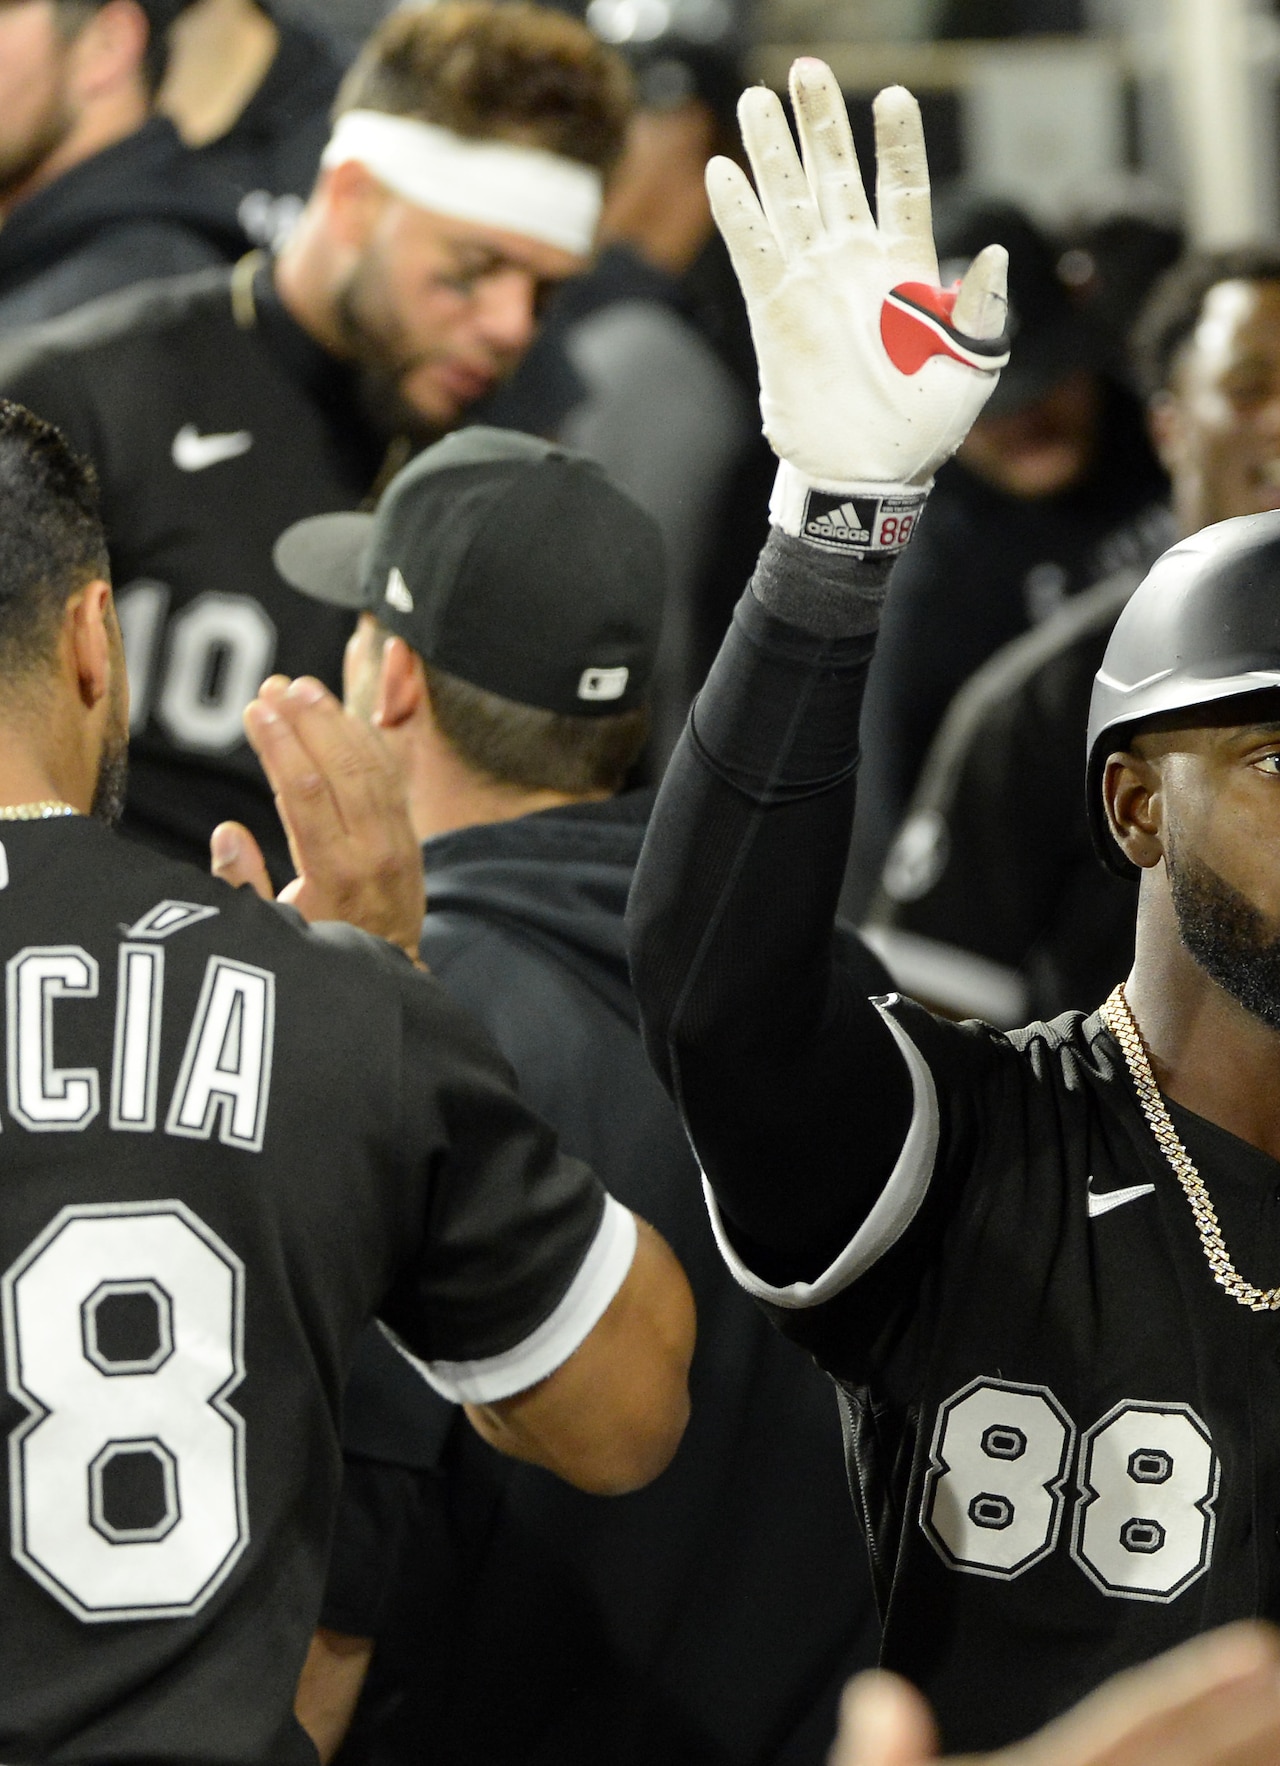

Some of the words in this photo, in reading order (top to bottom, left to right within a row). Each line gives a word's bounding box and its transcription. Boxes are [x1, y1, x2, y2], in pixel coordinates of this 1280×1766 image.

[806, 521, 870, 542] adidas
[0, 899, 276, 1153] CÍA
[1, 1199, 250, 1624] 8
[919, 1374, 1222, 1604] 88
